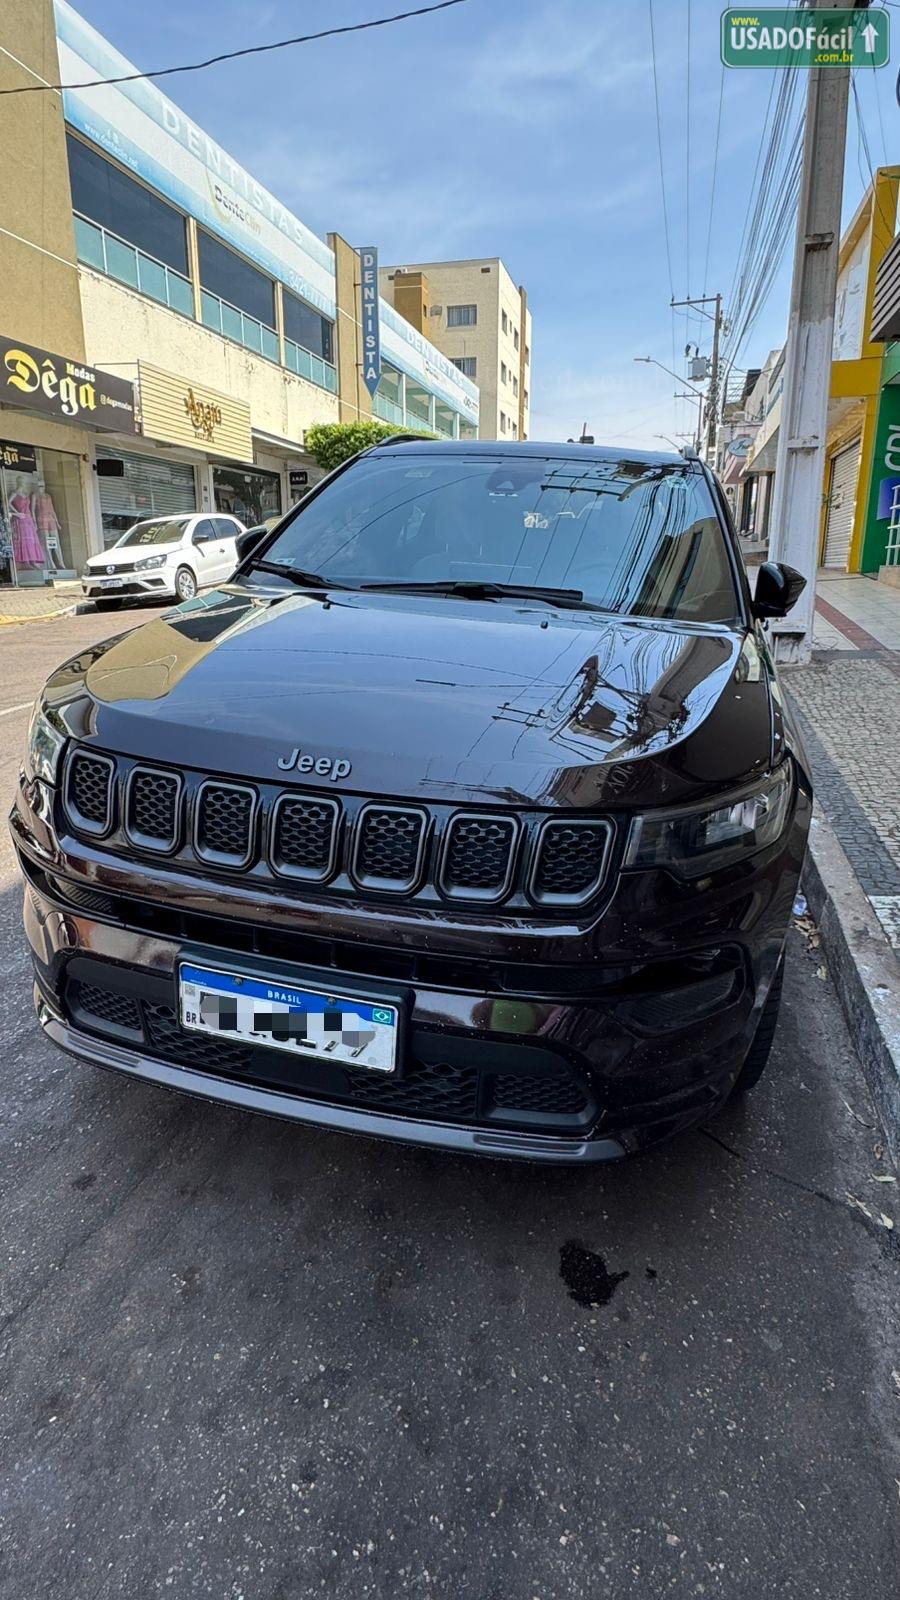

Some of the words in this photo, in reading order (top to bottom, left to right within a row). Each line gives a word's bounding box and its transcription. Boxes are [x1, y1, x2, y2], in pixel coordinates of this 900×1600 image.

[161, 99, 304, 242] DENTISTAS
[363, 253, 378, 380] DENTISTA
[4, 349, 97, 416] Dêga
[66, 362, 96, 383] Modas
[277, 748, 352, 781] Jeep
[267, 989, 302, 1005] BRASIL
[186, 1011, 197, 1024] BR
